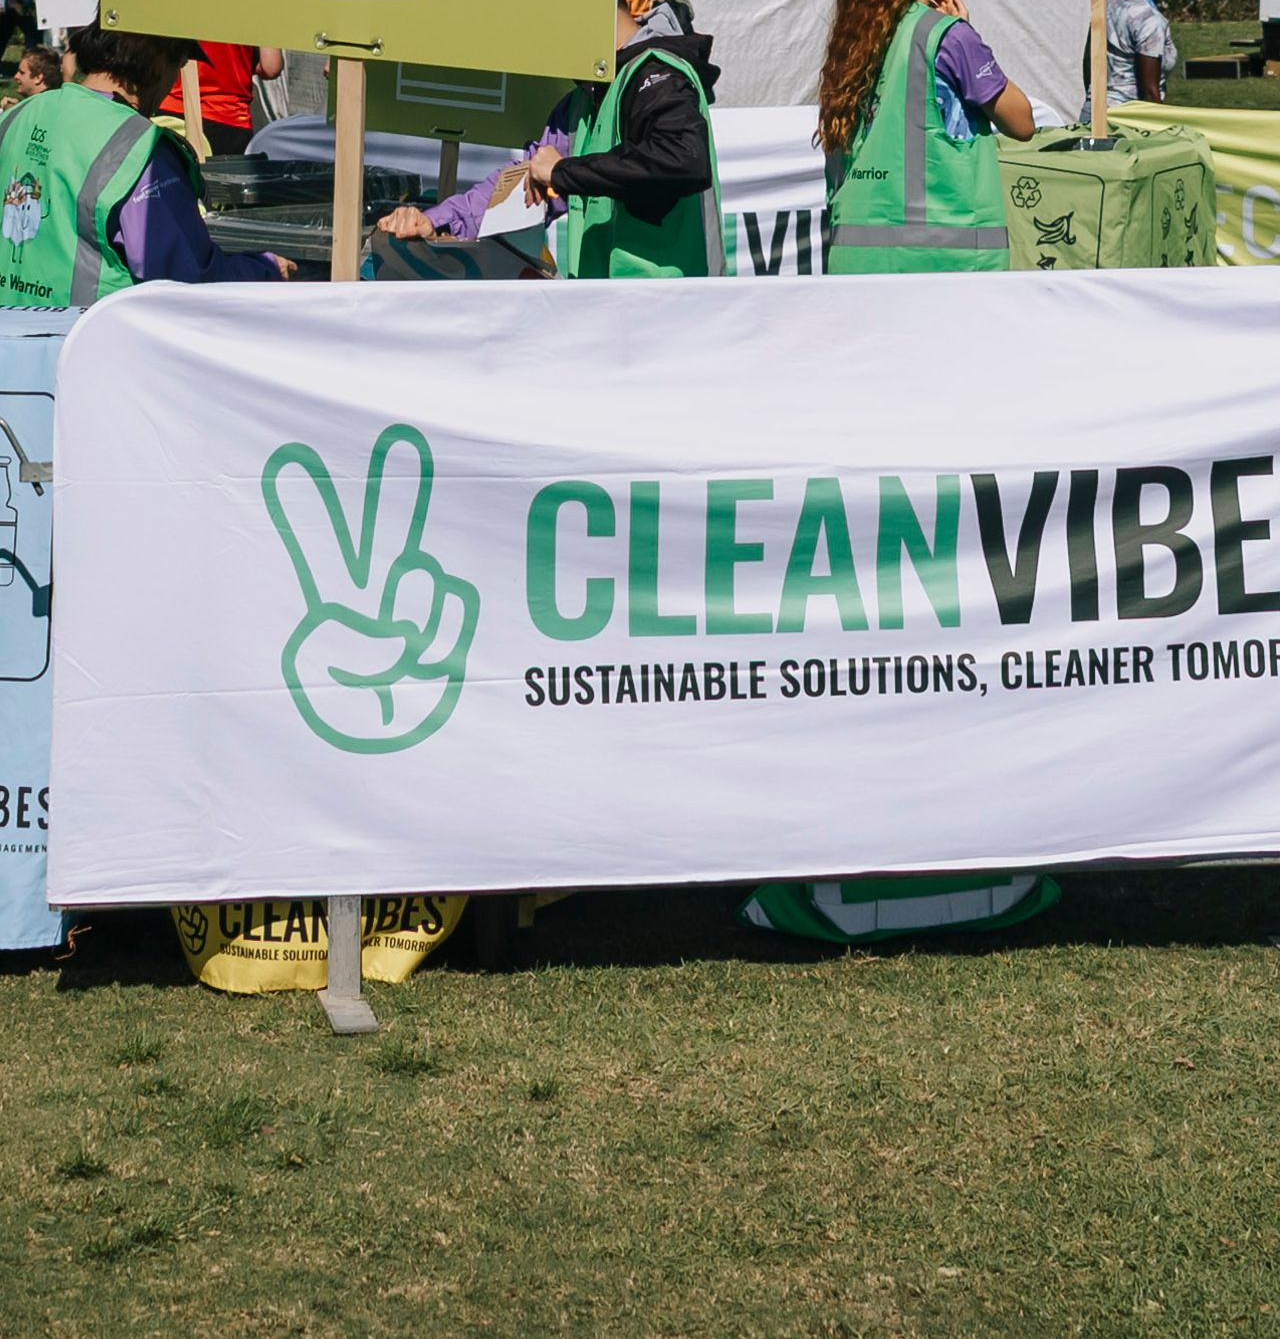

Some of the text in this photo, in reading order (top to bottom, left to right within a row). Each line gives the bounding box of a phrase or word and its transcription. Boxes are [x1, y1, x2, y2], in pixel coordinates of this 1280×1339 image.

[10, 273, 53, 299] Warrior
[525, 662, 766, 706] SUSTAINABLE
[781, 654, 990, 699] SOLUTIONS,
[1002, 647, 1153, 689] CLEANER
[220, 944, 279, 961] SUSTAINABLE
[282, 949, 329, 961] SOLUTIO
[385, 937, 432, 953] TOMORRO
